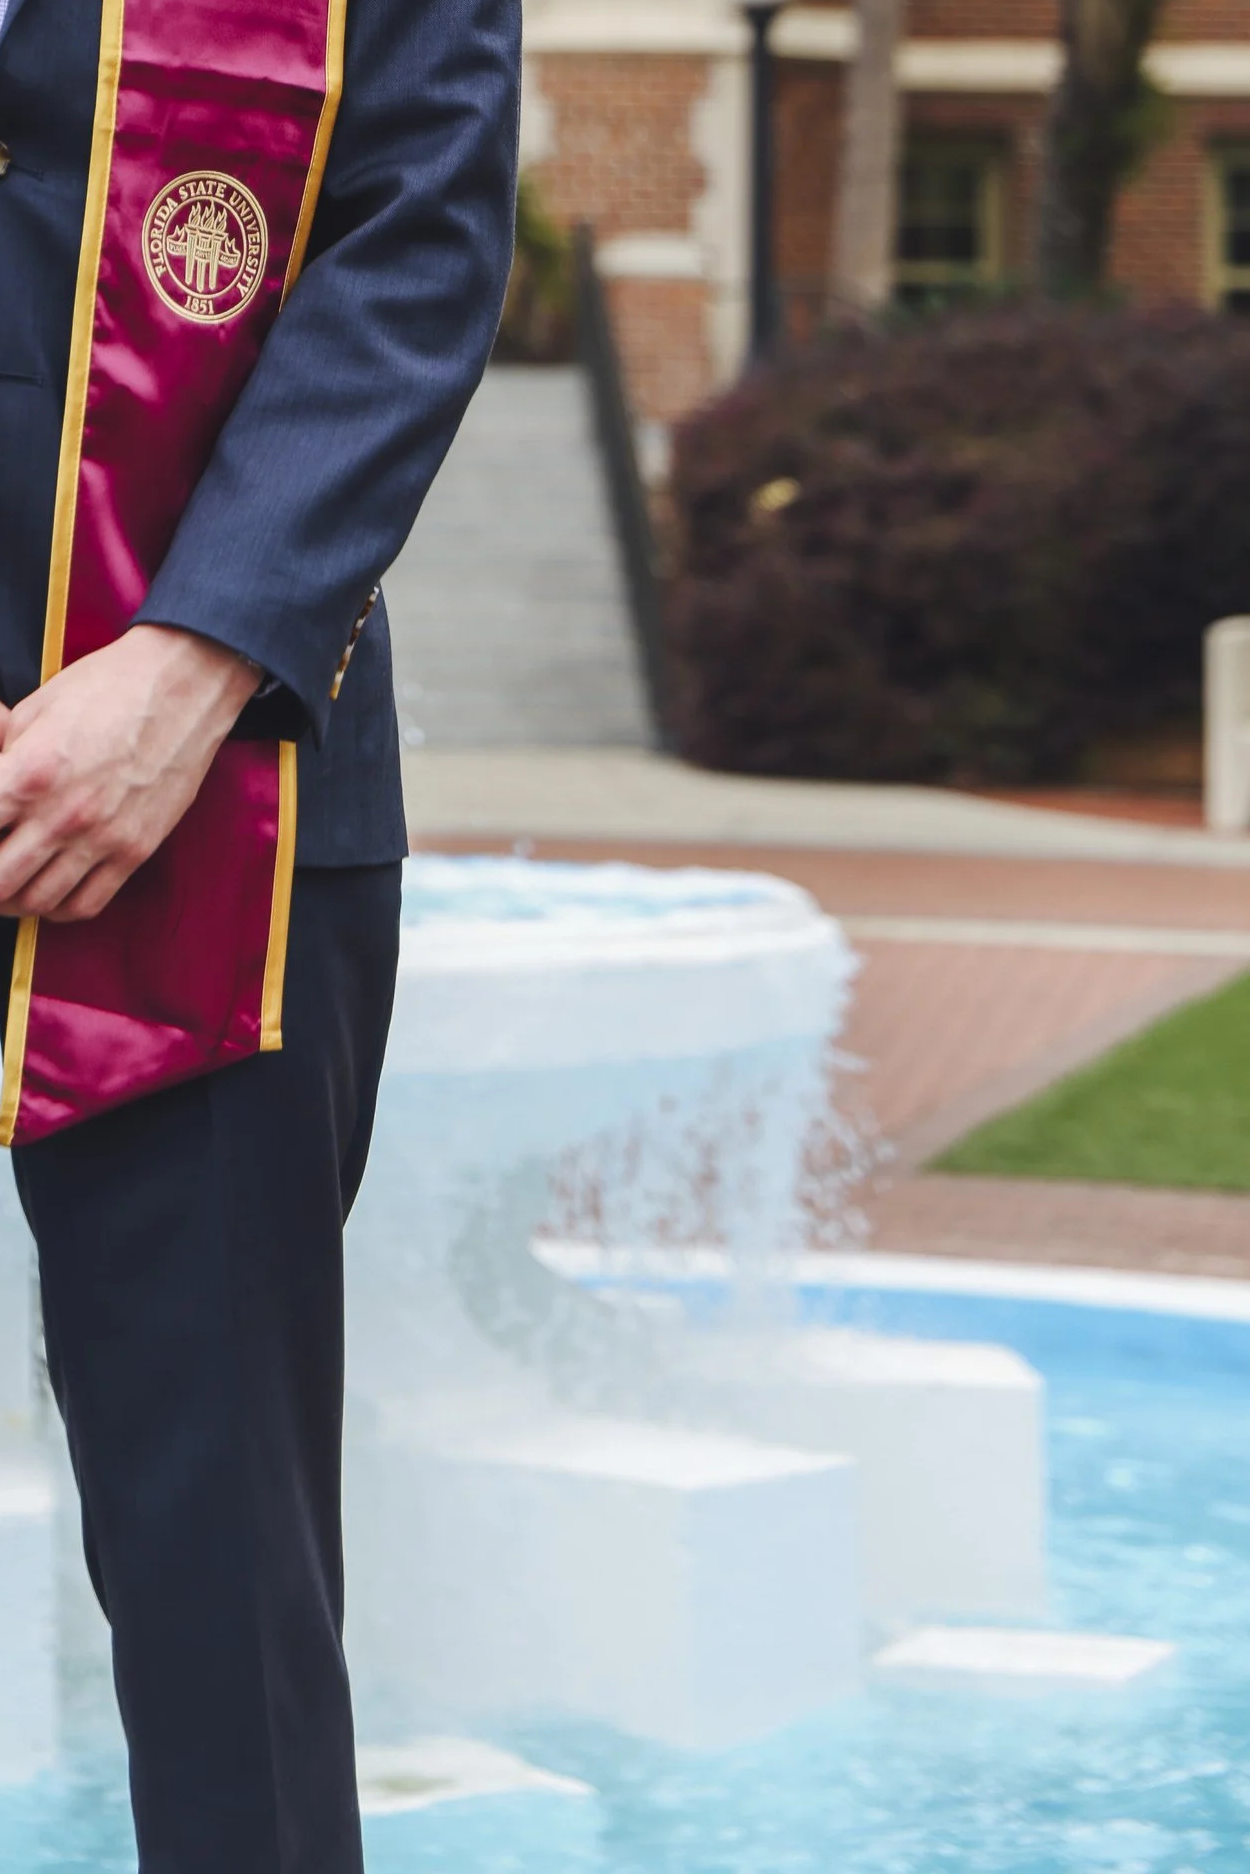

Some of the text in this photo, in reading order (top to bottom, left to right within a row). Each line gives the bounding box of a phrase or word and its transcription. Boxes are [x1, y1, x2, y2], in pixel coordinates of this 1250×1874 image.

[150, 180, 260, 298] FLORIDA STATE UNIVERSITY
[184, 296, 214, 315] 1851
